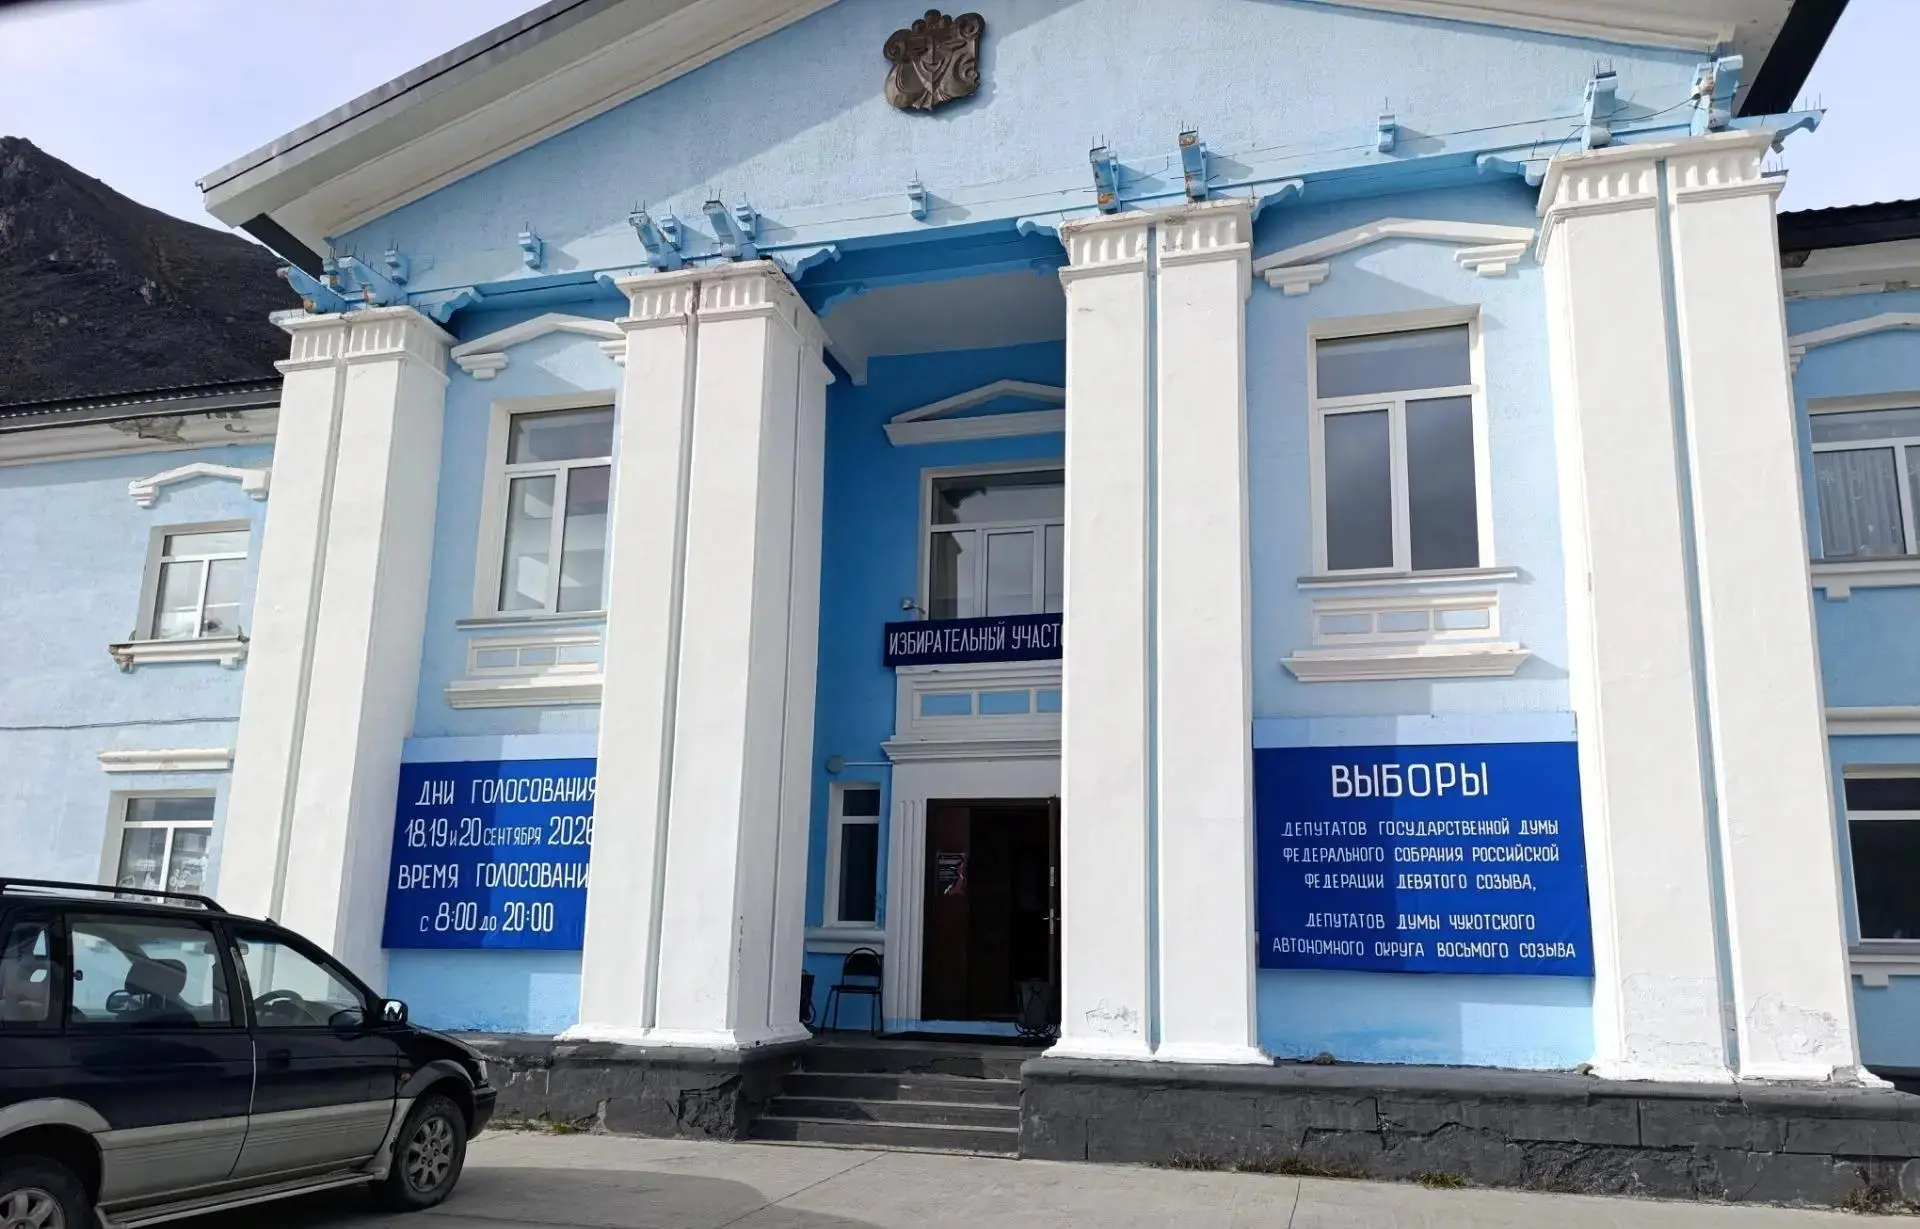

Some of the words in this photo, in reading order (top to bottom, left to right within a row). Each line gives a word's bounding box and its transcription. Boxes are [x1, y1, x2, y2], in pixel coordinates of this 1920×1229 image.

[889, 621, 1005, 656] ИЗБИРАТЕЛЬНЫЙ
[1011, 623, 1064, 650] УЧАСТ
[415, 781, 454, 805] ДНИ
[471, 777, 596, 804] ГОЛОСОВАНИЯ
[1332, 762, 1488, 797] ВЫБОРЫ
[459, 818, 481, 846] 20
[484, 827, 541, 846] СЕНТЯБРЯ
[1282, 822, 1367, 836] ДЕПУТАТОВ
[1379, 818, 1509, 836] ГОСУДАРСТВЕННОЙ
[1518, 820, 1558, 834] ДУМЫ
[1284, 847, 1384, 862] ФЕДЕРАЛЬНОГО
[1395, 847, 1463, 862] СОБРАНИЯ
[1473, 844, 1559, 862] РОССИЙСКОЙ
[398, 864, 458, 889] ВРЕМЯ
[1305, 874, 1384, 888] ФЕДЕРАЦИИ
[1397, 874, 1467, 889] ДЕВЯТОГО
[1477, 874, 1536, 891] СОЗЫВА,
[435, 902, 477, 931] 8:00
[503, 902, 553, 932] 20:00
[1306, 913, 1385, 929] ДЕПУТАТОВ
[1397, 914, 1440, 929] ДУМЫ
[1449, 914, 1535, 930] ЧУКОТСКОГО
[1273, 938, 1364, 956] АВТОНОМНОГО
[1375, 942, 1424, 957] ОКРУГА
[1437, 942, 1508, 958] ВОСЬМОГО
[1520, 943, 1575, 958] СОЗЫВА
